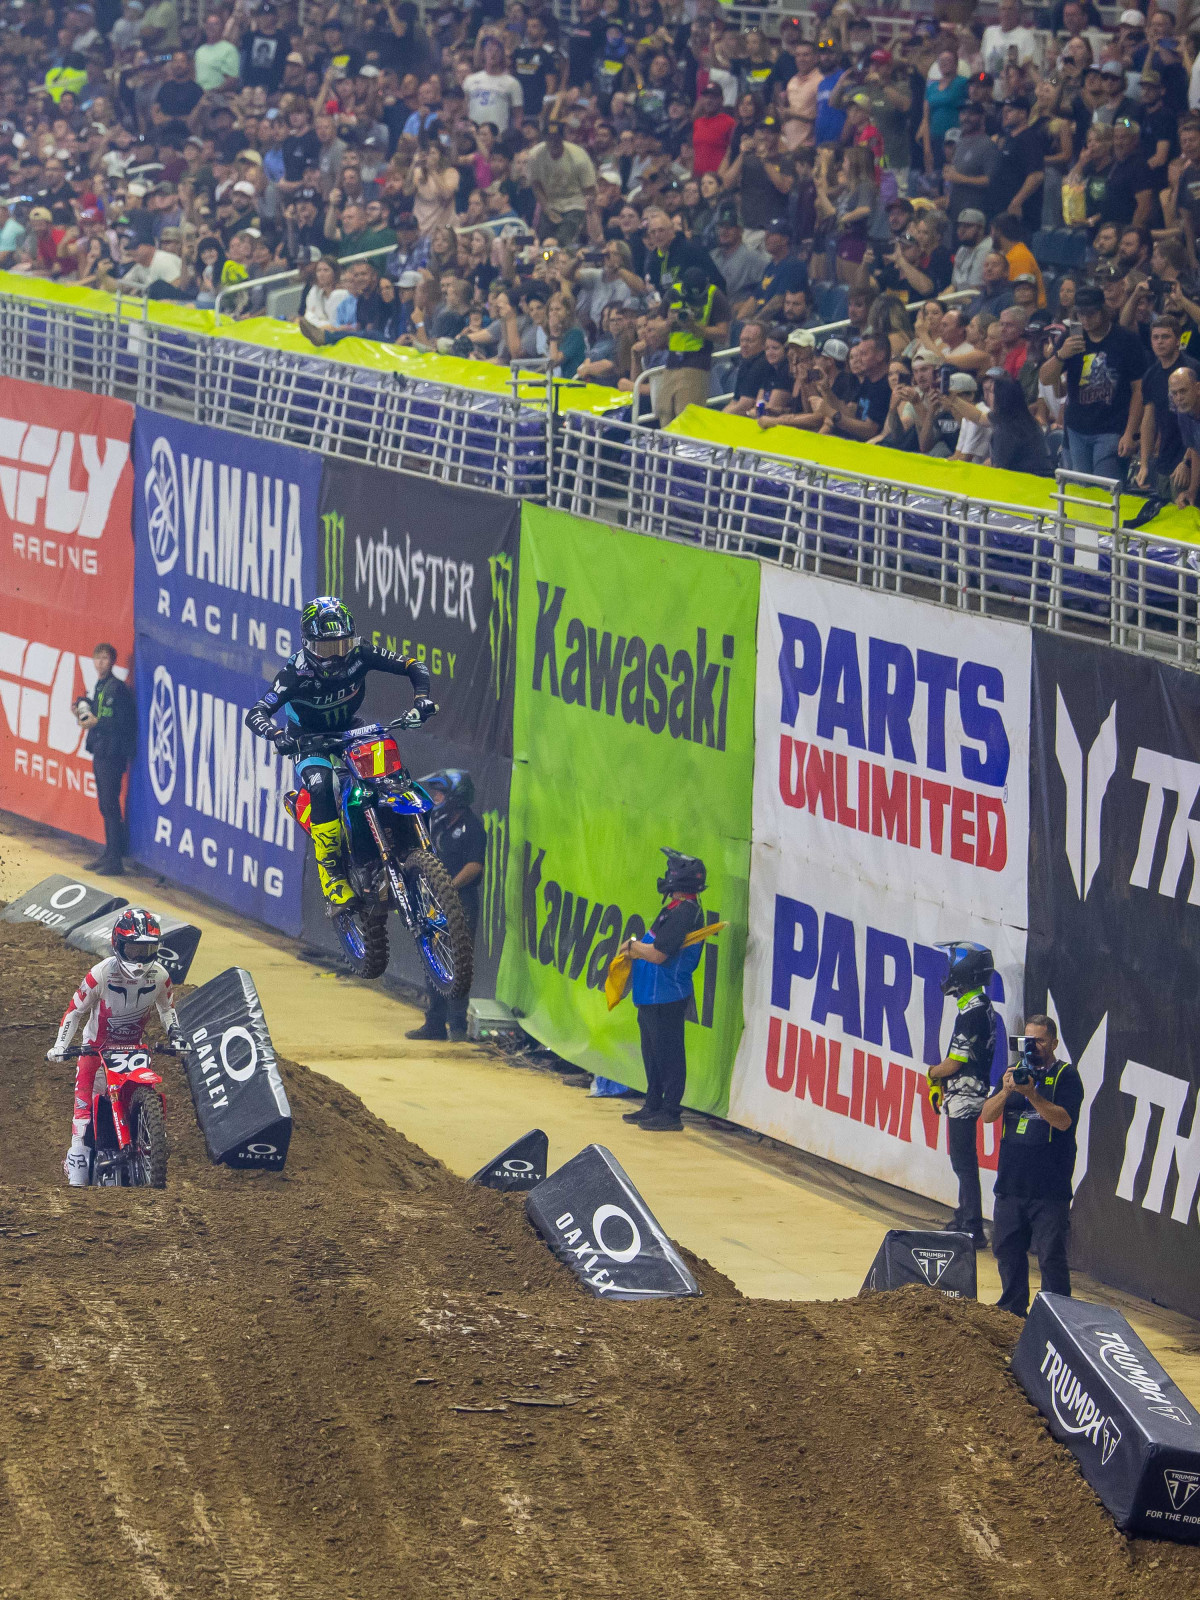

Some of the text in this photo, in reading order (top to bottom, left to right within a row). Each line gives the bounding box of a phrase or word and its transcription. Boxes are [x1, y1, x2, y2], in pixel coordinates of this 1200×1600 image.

[12, 533, 98, 576] RACING
[181, 453, 302, 612] YAMAHA
[355, 528, 477, 633] MONSTER
[157, 588, 292, 659] RACING
[531, 579, 736, 752] Kawasaki
[777, 611, 1011, 788] PARTS
[14, 748, 98, 799] RACING
[178, 684, 295, 851] YAMAHA
[371, 741, 385, 777] 1
[778, 733, 1008, 873] UNLIMITED
[155, 817, 284, 898] RACING
[770, 893, 1009, 1090] PART
[108, 1053, 151, 1073] 30
[191, 1026, 229, 1110] OAKLEY
[238, 1151, 283, 1162] OAKLEY
[494, 1169, 542, 1180] OAKLEY
[555, 1212, 617, 1294] OAKLEY
[919, 1251, 946, 1259] TRIUMPH
[1039, 1340, 1105, 1445] TRIUMPH
[1095, 1330, 1171, 1408] TRIUMPH
[1145, 1509, 1163, 1519] FOR
[1164, 1511, 1181, 1521] THE
